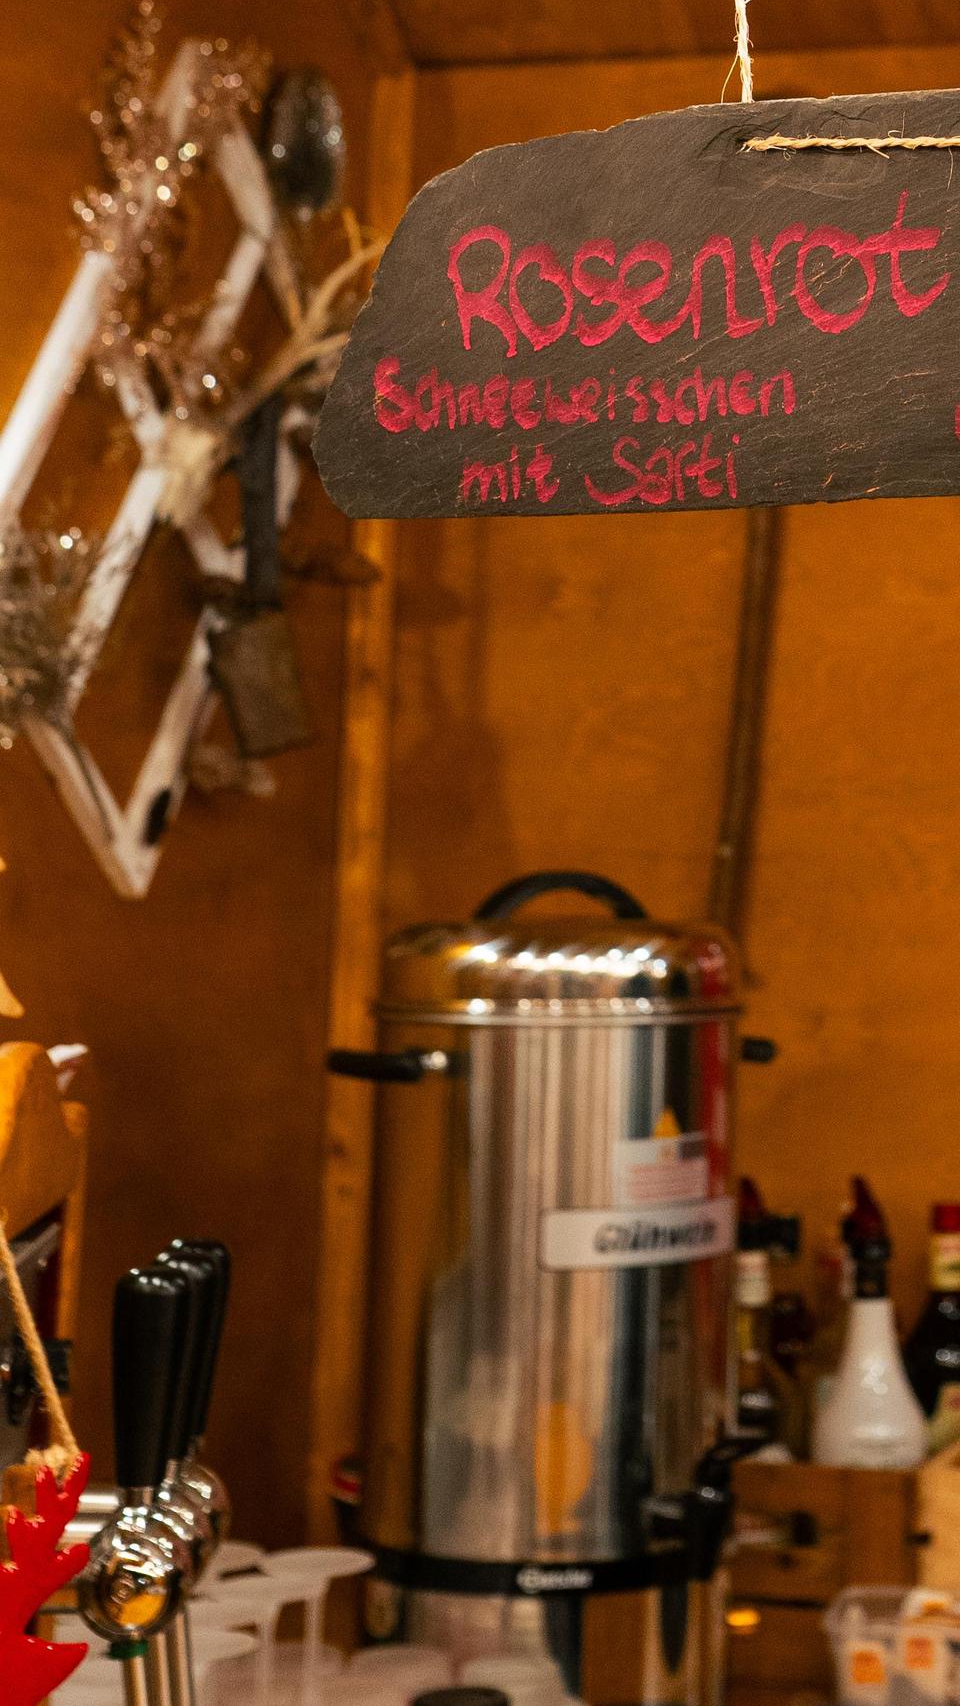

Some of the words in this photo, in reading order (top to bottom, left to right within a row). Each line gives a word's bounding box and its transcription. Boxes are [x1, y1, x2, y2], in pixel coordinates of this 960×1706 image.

[447, 189, 952, 358] Rosenrot
[373, 356, 796, 433] Schneeweisschen
[460, 443, 560, 503] mit
